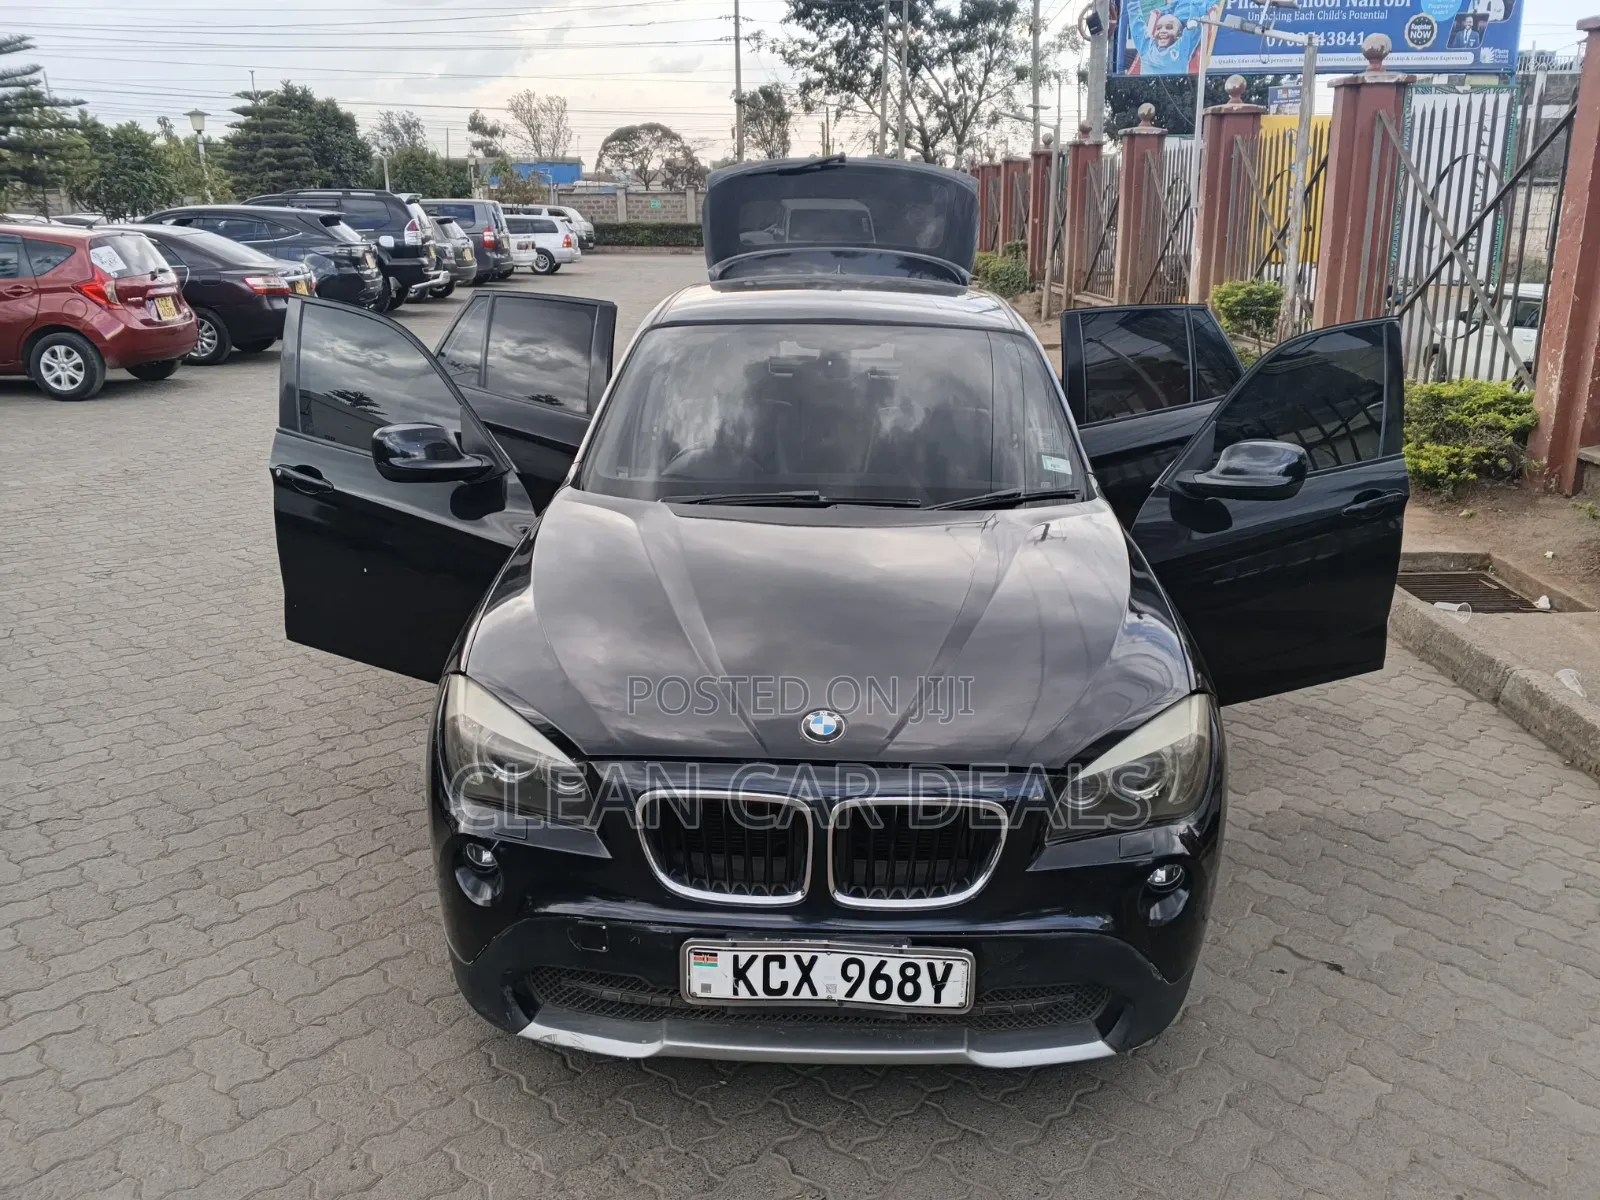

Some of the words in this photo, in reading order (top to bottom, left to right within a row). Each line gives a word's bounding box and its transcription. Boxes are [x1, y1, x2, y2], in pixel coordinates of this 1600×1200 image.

[1294, 10, 1315, 21] Each
[1317, 9, 1347, 20] Child's
[1349, 9, 1388, 20] Potential
[1410, 23, 1432, 31] Register
[1410, 31, 1432, 39] NOW
[732, 954, 819, 997] KCX
[840, 957, 954, 1004] 968Y
